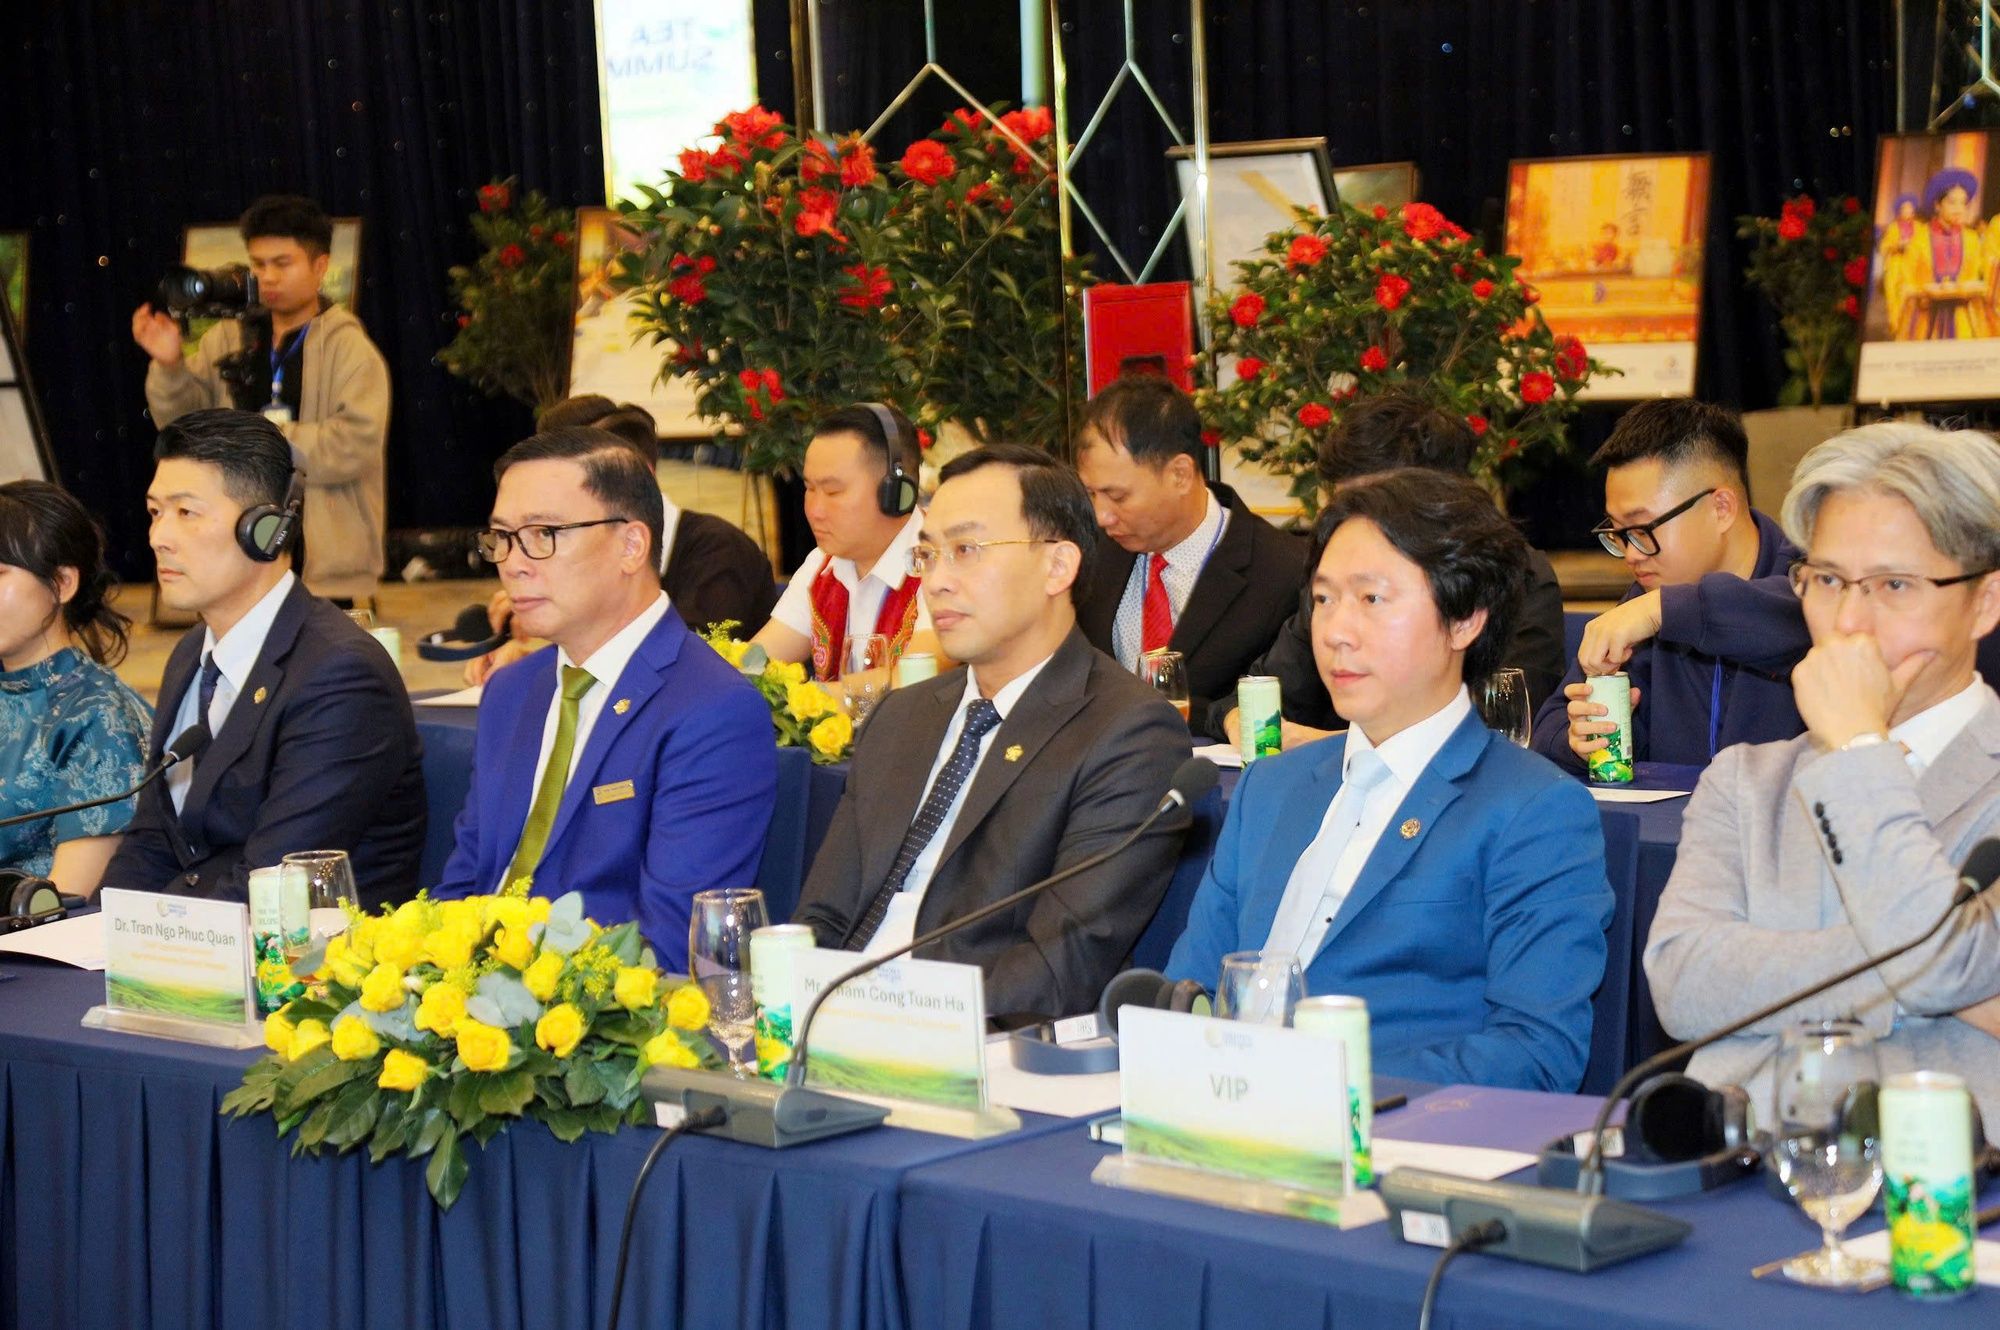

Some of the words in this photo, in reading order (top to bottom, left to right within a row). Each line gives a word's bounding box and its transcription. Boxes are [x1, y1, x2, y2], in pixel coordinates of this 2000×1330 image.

[114, 918, 129, 932] Dr.
[131, 920, 152, 935] Tran
[155, 924, 175, 941] Ngo
[178, 926, 205, 942] Phuc
[207, 930, 235, 946] Quan
[869, 985, 905, 1008] Cong
[907, 990, 941, 1009] Tuan
[944, 994, 965, 1012] Ha
[1209, 1073, 1249, 1102] VIP
